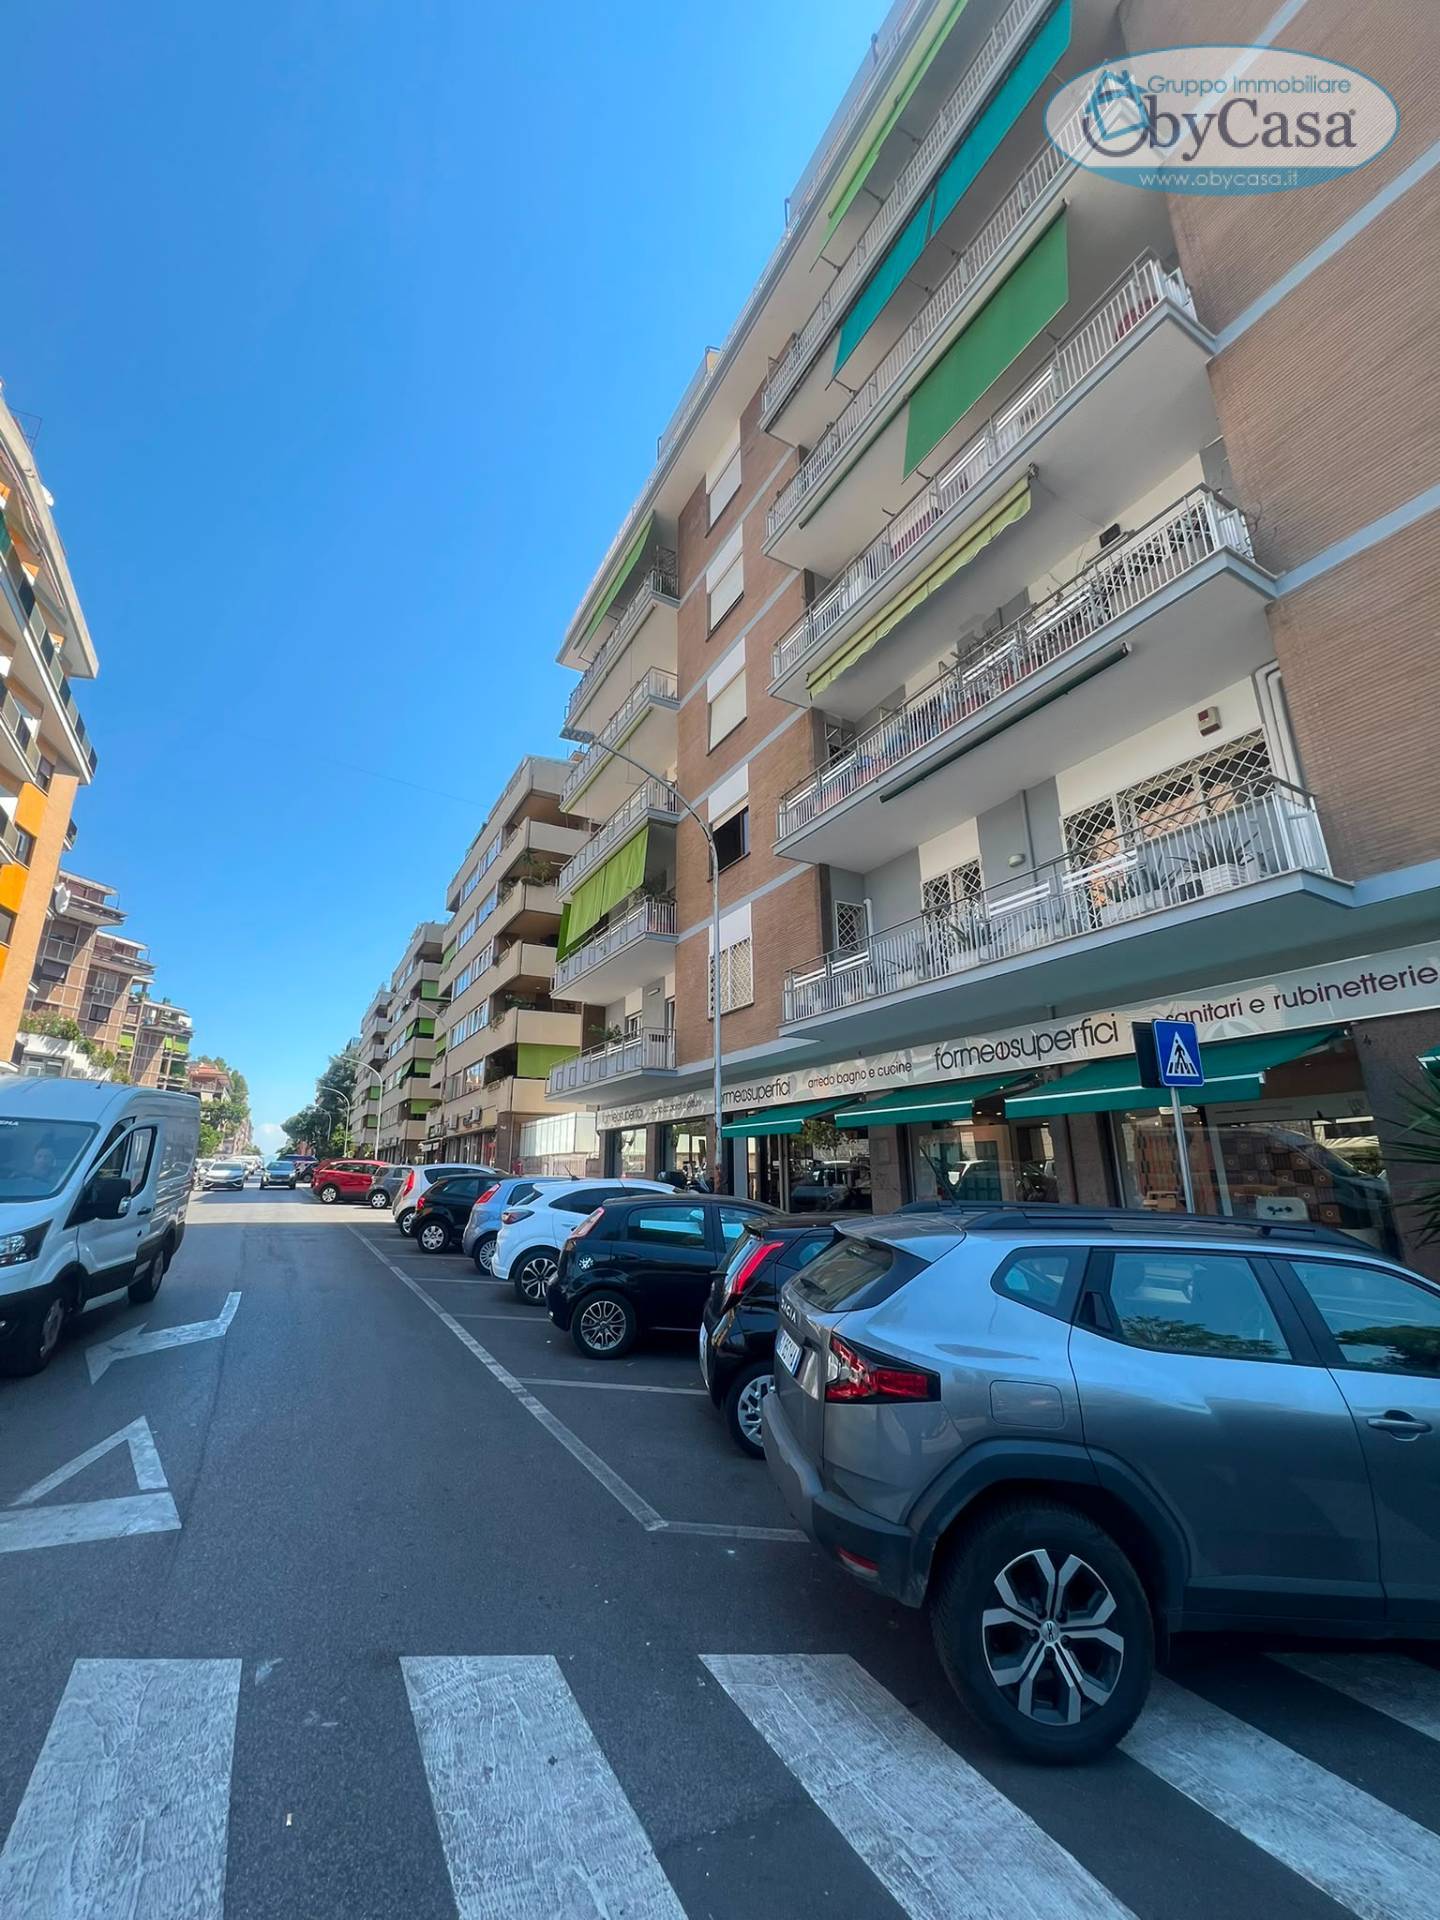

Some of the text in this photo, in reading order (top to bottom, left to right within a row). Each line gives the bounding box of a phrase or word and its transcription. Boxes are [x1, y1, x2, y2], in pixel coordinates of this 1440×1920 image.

[1249, 998, 1265, 1014] e
[1274, 965, 1439, 1010] rubinetterie
[807, 1075, 836, 1089] arredo
[837, 1069, 867, 1087] bagno
[878, 1060, 913, 1077] cucine
